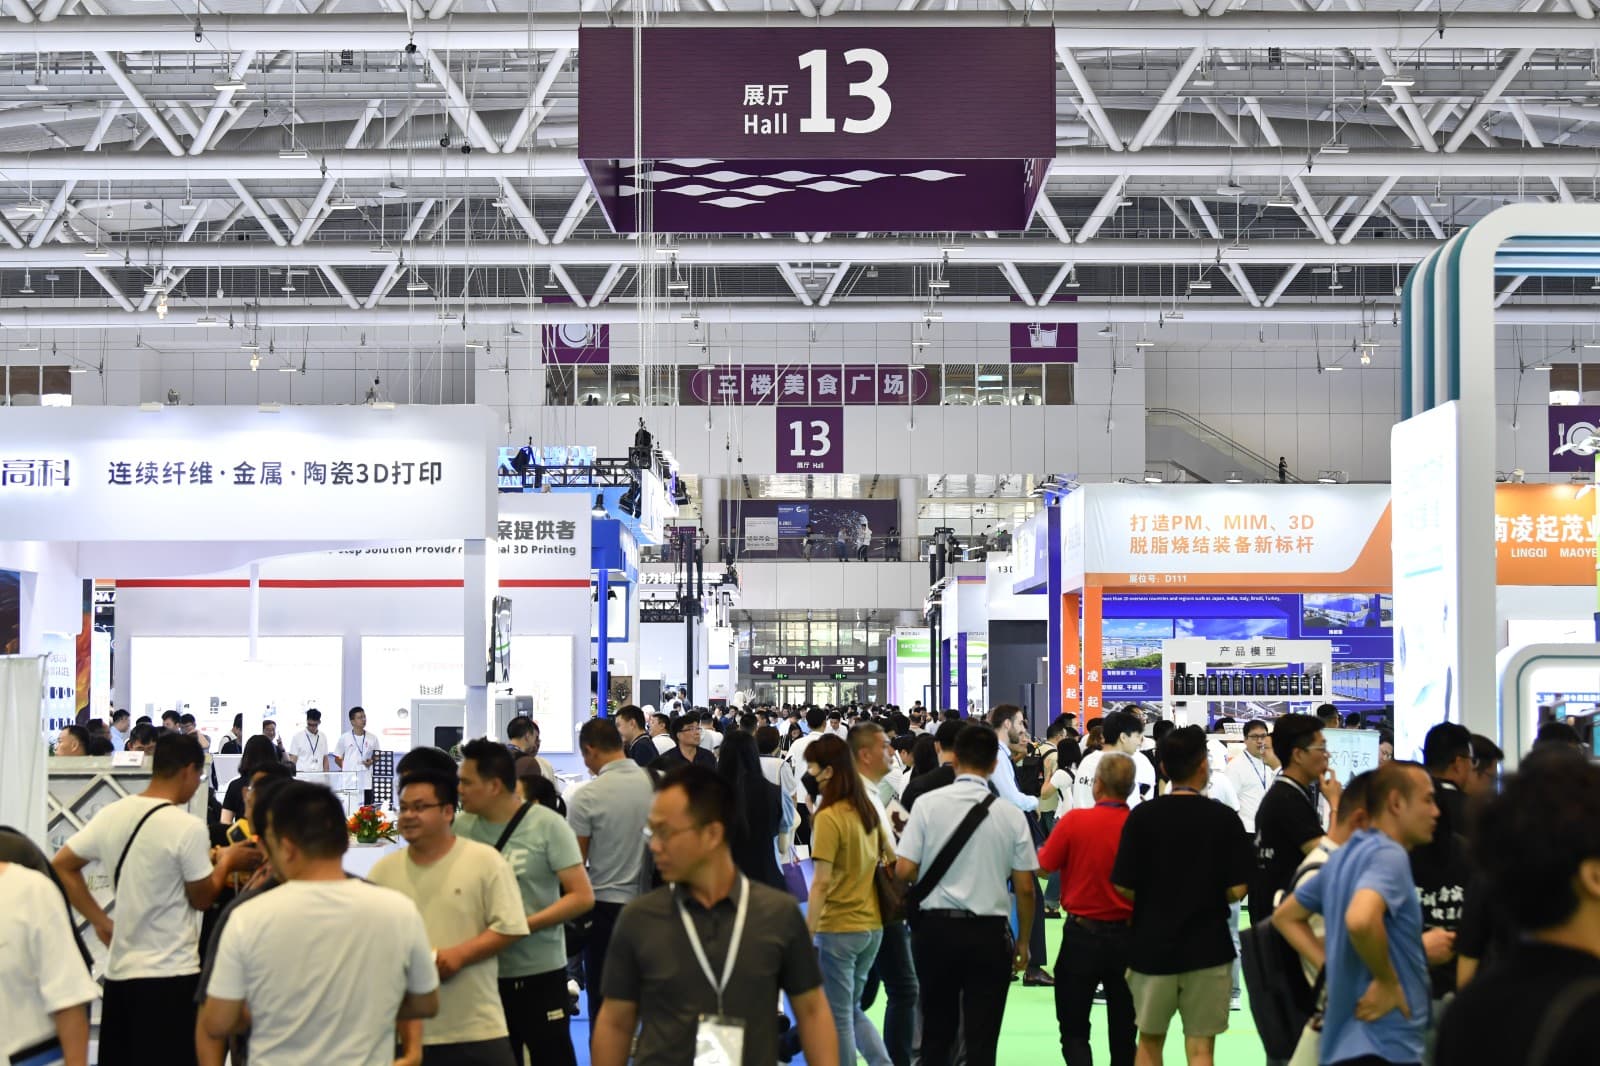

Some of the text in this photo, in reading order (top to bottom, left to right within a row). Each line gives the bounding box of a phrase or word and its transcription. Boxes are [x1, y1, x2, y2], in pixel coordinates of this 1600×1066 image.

[743, 84, 789, 106] 展厅
[798, 47, 892, 134] 13
[744, 112, 788, 135] Hall
[718, 374, 905, 396] 三楼美食广场
[789, 420, 831, 457] 13
[2, 459, 70, 487] 高科
[514, 545, 528, 554] 3D
[531, 545, 576, 556] Printing
[1130, 536, 1314, 554] 脱脂烧结装备新标杆
[1511, 548, 1547, 558] LINGQI
[1219, 646, 1277, 656] 产品模型
